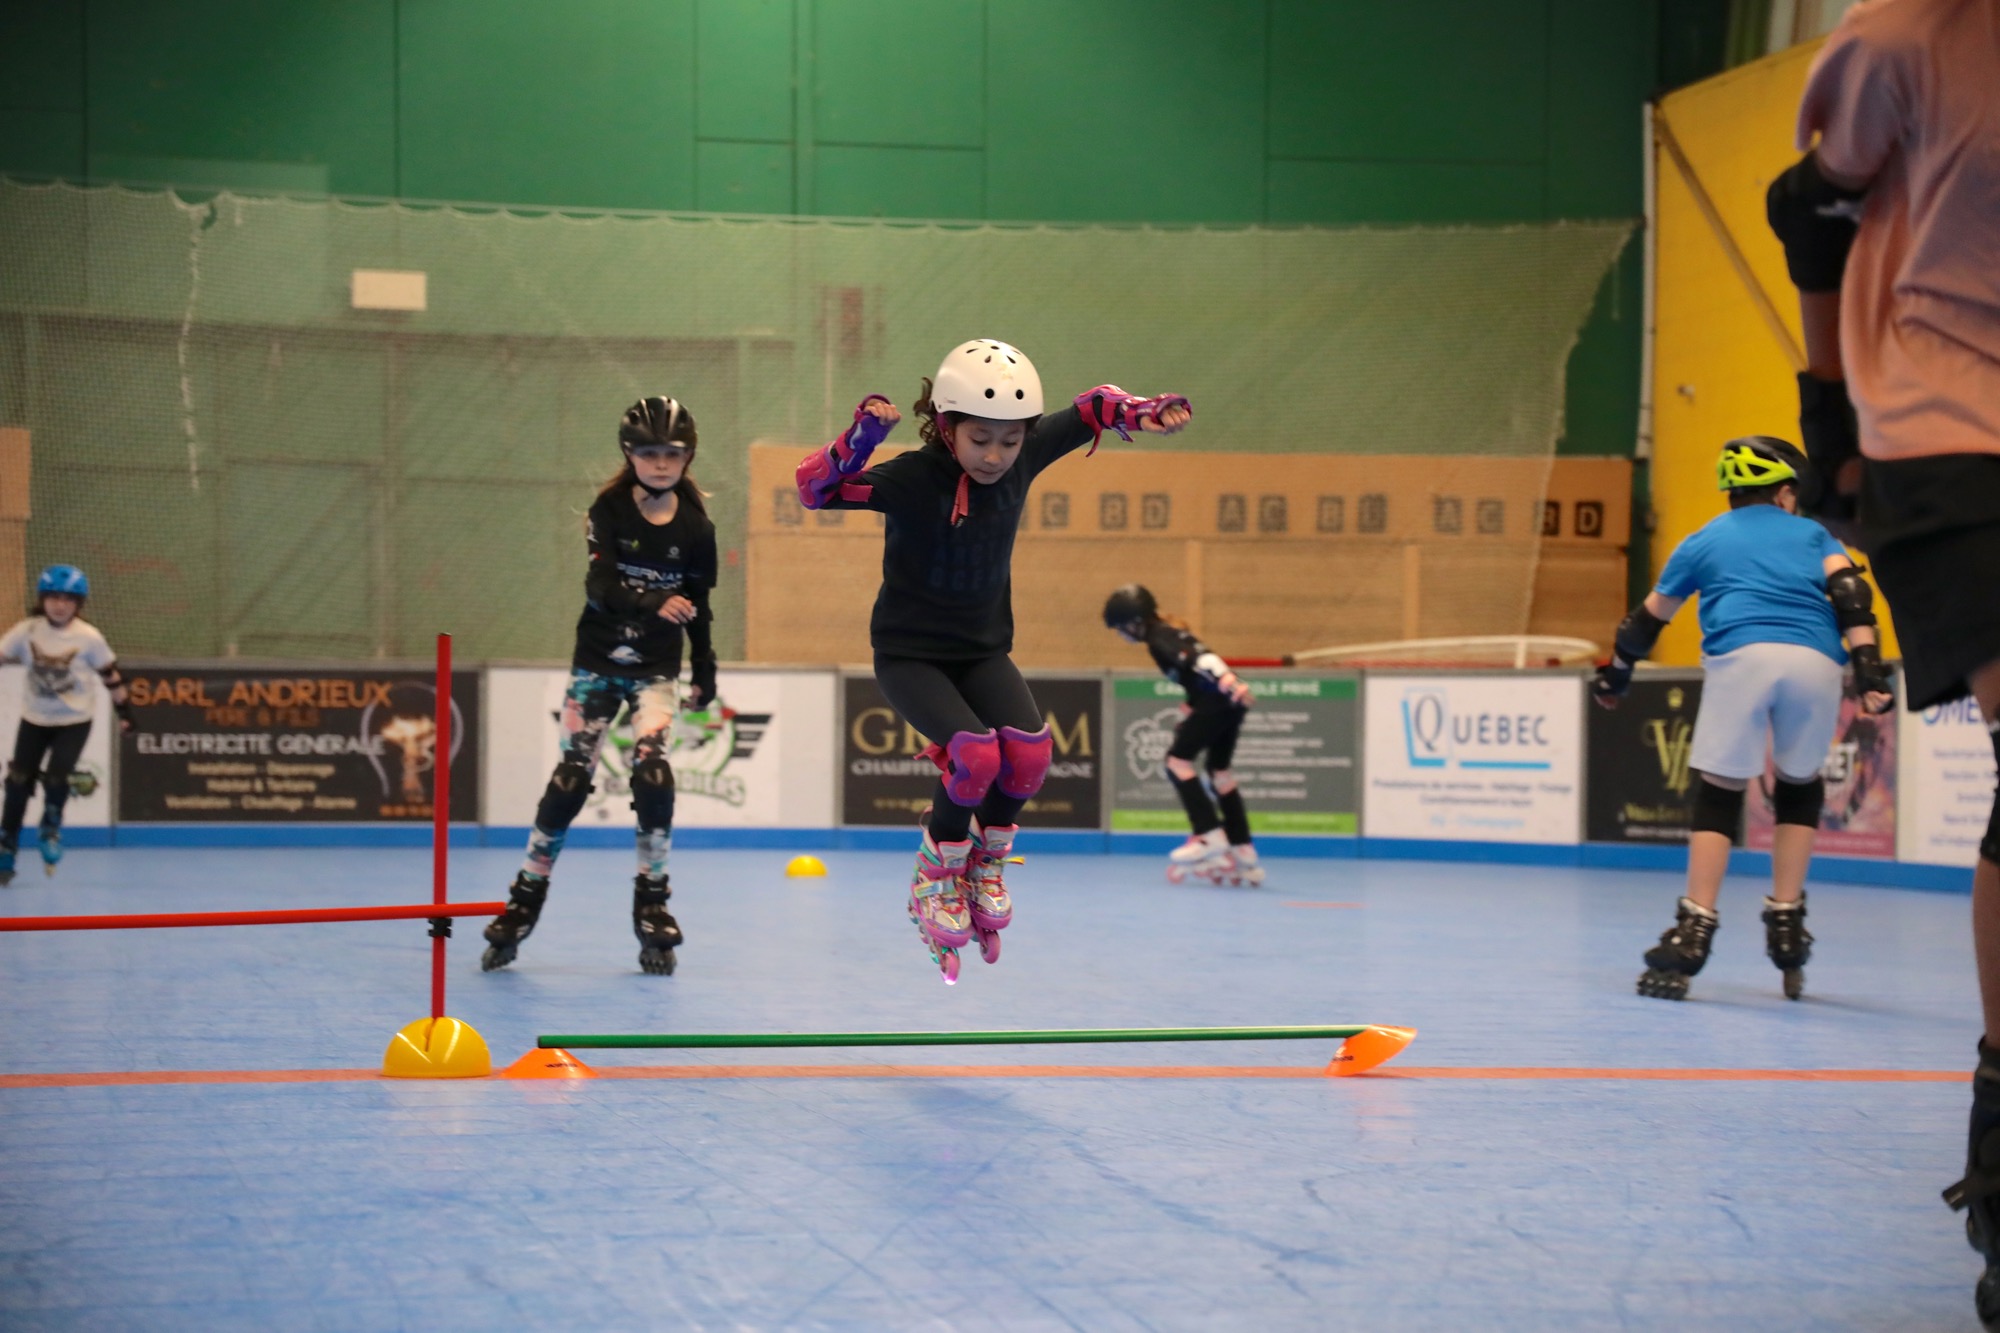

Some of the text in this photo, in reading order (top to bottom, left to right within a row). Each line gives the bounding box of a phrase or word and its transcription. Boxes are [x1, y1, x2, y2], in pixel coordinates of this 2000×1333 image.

[130, 677, 394, 708] SARL ANDRIEUX
[1414, 696, 1548, 751] QUÉBEC
